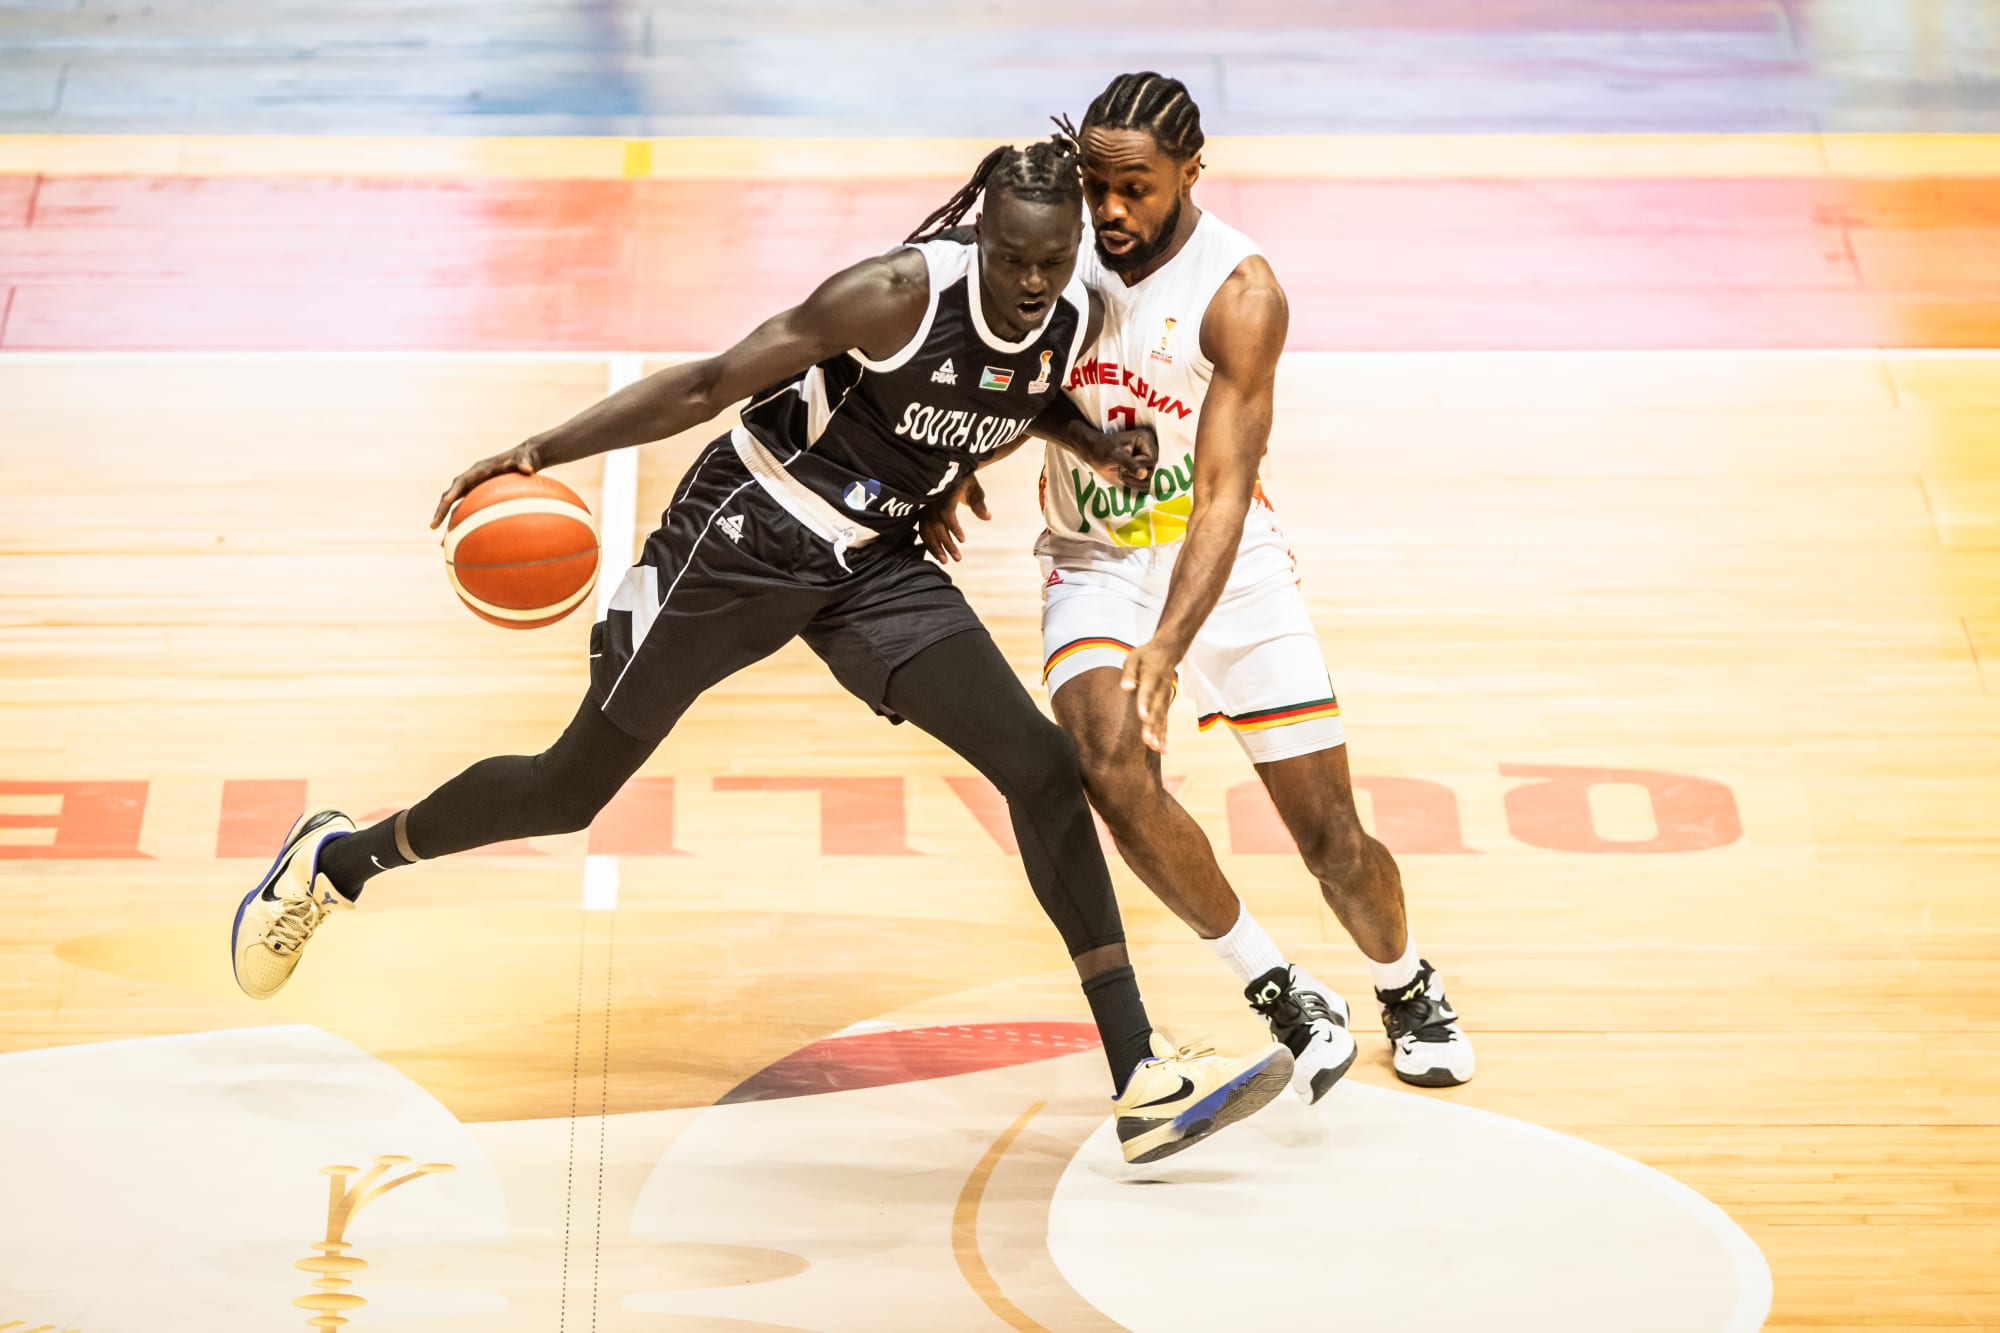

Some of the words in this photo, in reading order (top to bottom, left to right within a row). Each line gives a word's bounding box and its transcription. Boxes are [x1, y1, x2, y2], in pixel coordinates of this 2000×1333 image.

[930, 370, 959, 386] PEAK
[1062, 356, 1193, 420] AMEROUN
[894, 401, 978, 447] SOUTH
[968, 415, 1035, 454] SUDA
